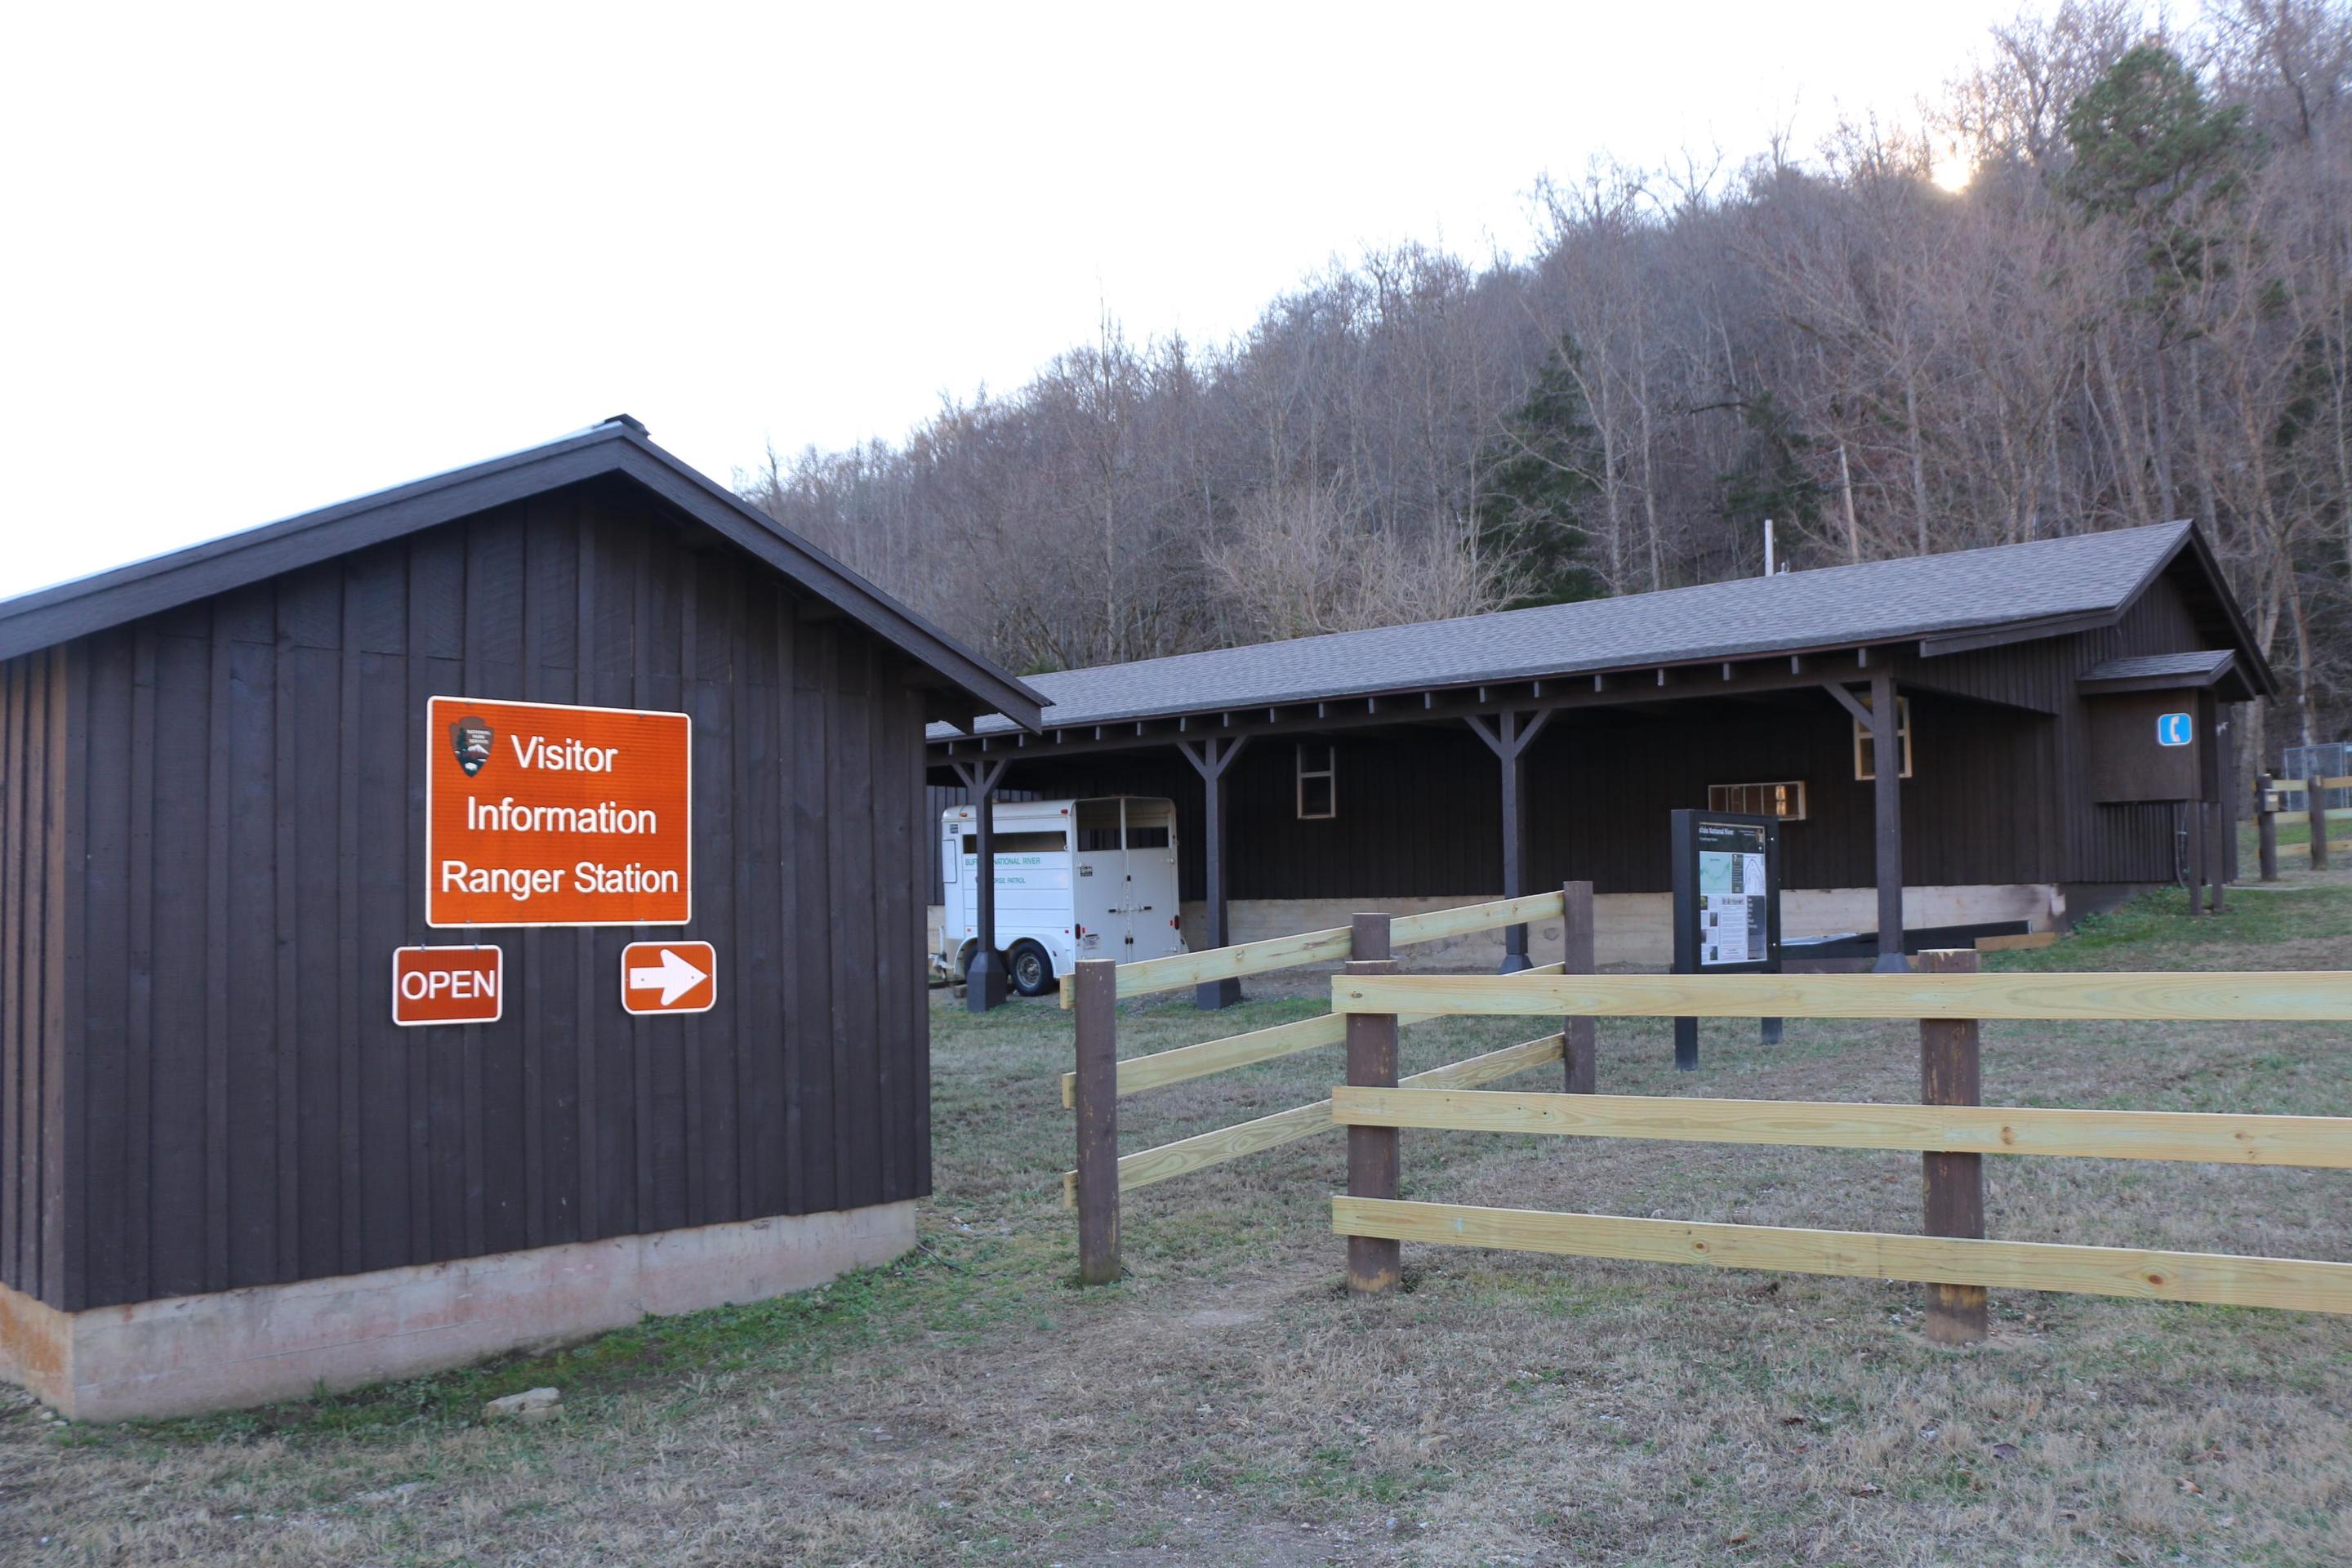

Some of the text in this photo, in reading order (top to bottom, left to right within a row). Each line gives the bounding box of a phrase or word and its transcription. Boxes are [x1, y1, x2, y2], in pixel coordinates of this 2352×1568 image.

[510, 734, 619, 773] Visitor
[467, 795, 657, 835] Information
[442, 860, 679, 902] Ranger Station
[400, 969, 496, 1000] OPEN
